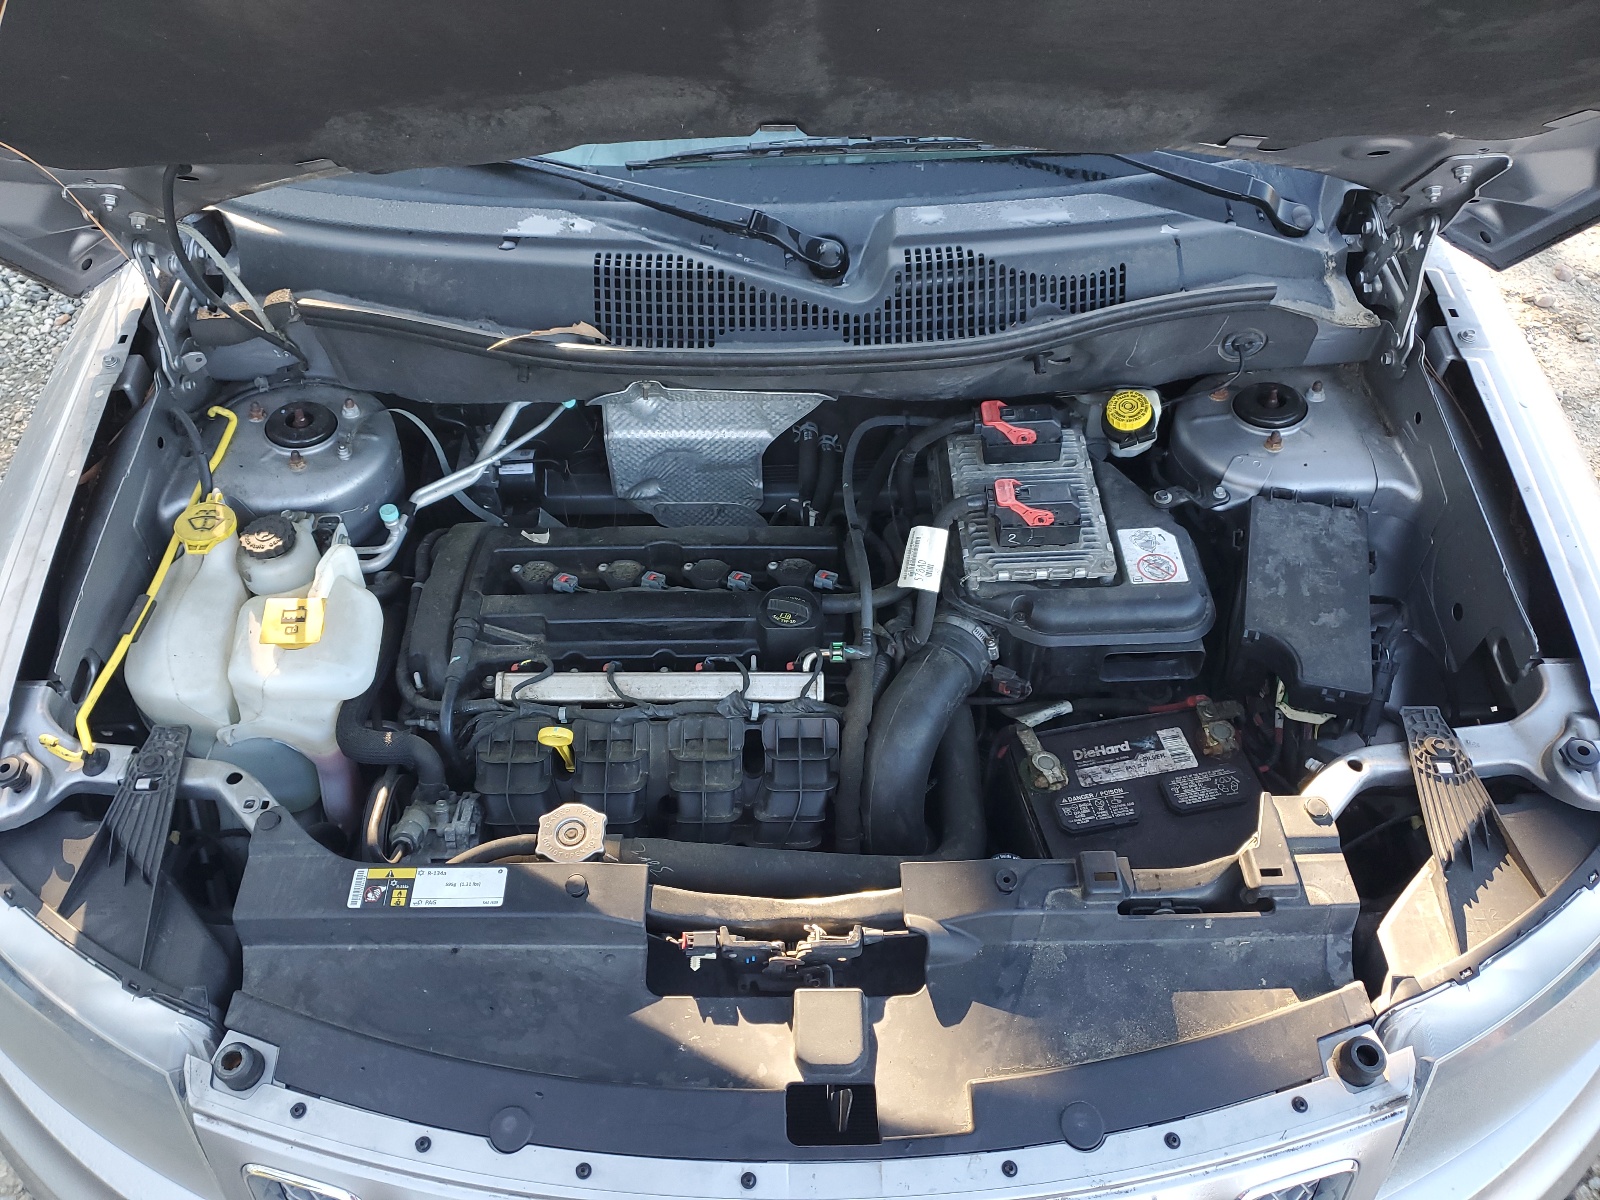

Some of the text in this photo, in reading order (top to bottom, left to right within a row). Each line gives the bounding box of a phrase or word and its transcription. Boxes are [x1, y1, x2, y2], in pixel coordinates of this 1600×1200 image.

[1072, 740, 1131, 761] DieHard
[1067, 792, 1094, 803] DANGER
[1100, 787, 1124, 797] POISON
